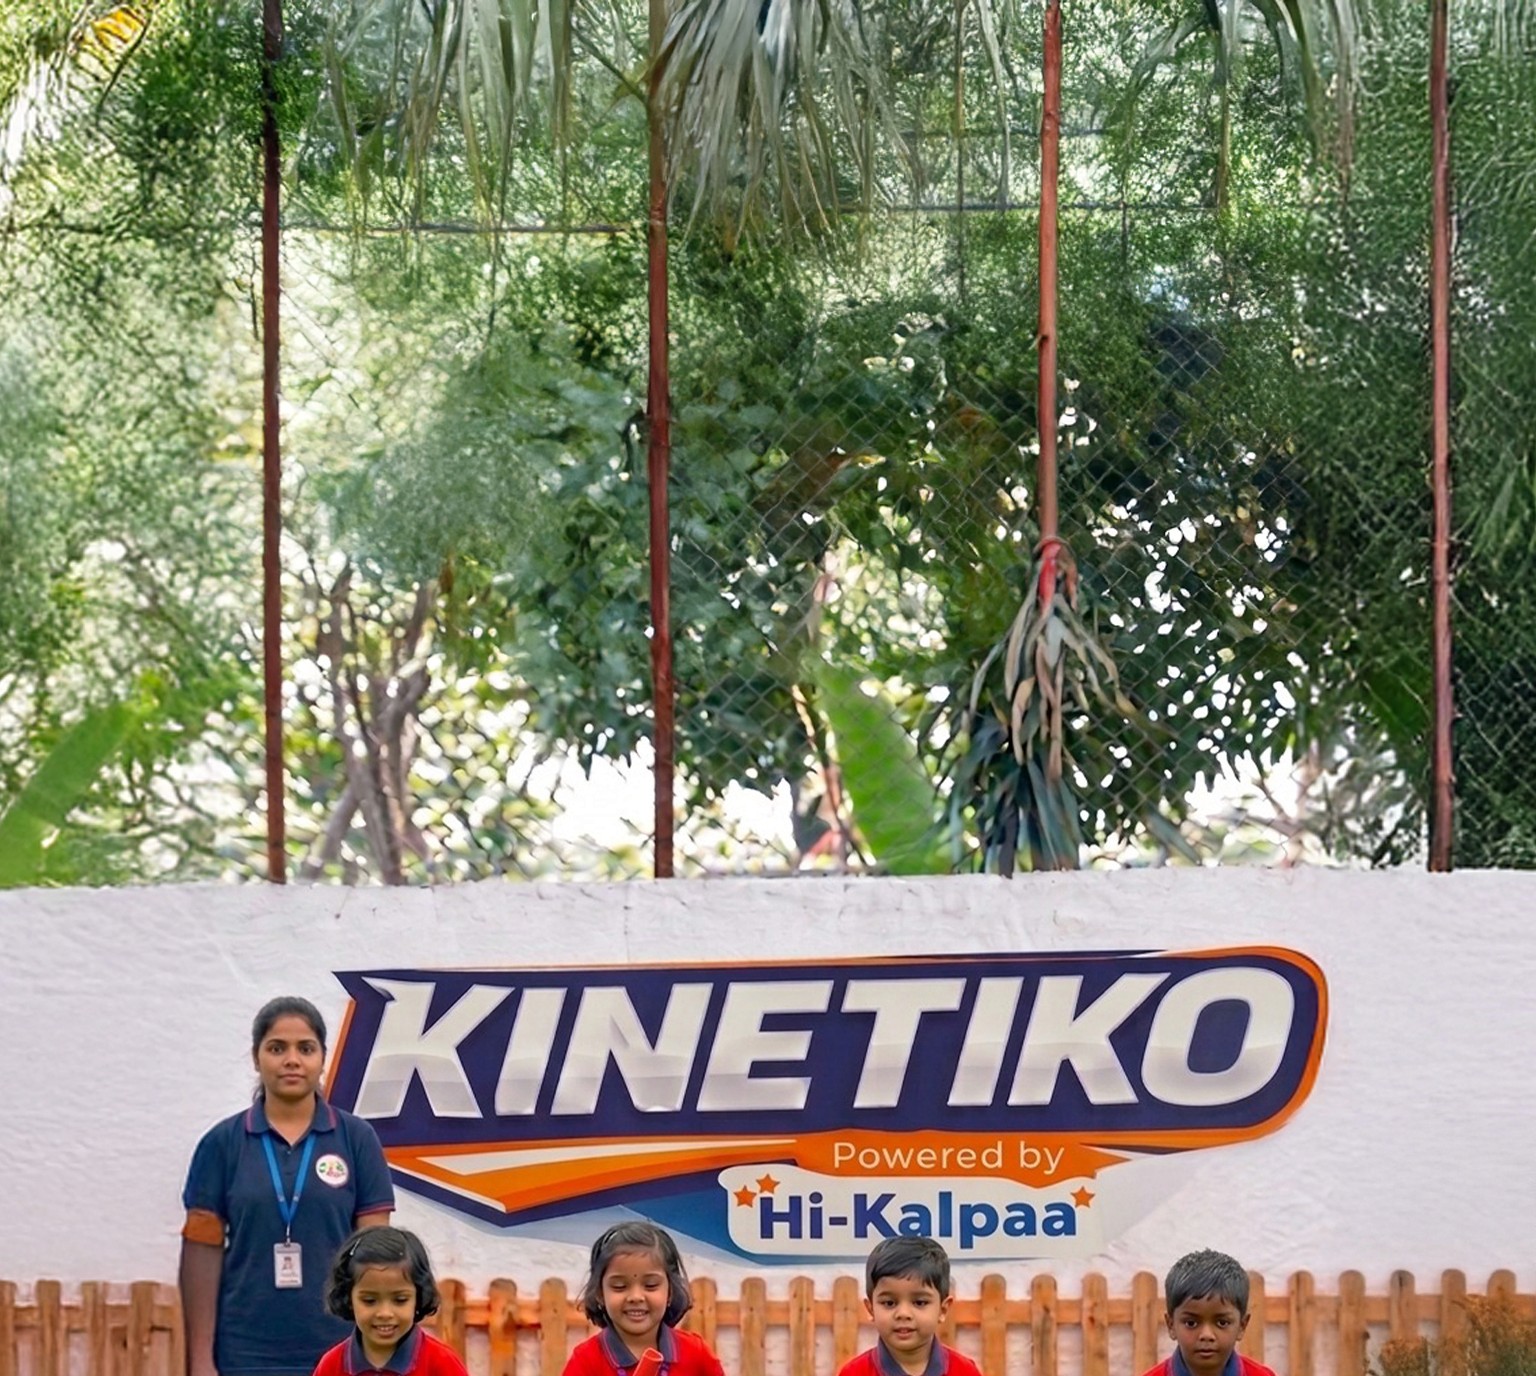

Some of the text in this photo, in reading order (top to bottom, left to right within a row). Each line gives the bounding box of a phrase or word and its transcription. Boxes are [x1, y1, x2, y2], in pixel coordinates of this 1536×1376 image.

[352, 966, 1295, 1119] KINETIKO
[833, 1140, 1065, 1175] Powered by
[759, 1190, 1077, 1249] Hi-Kalpaa
